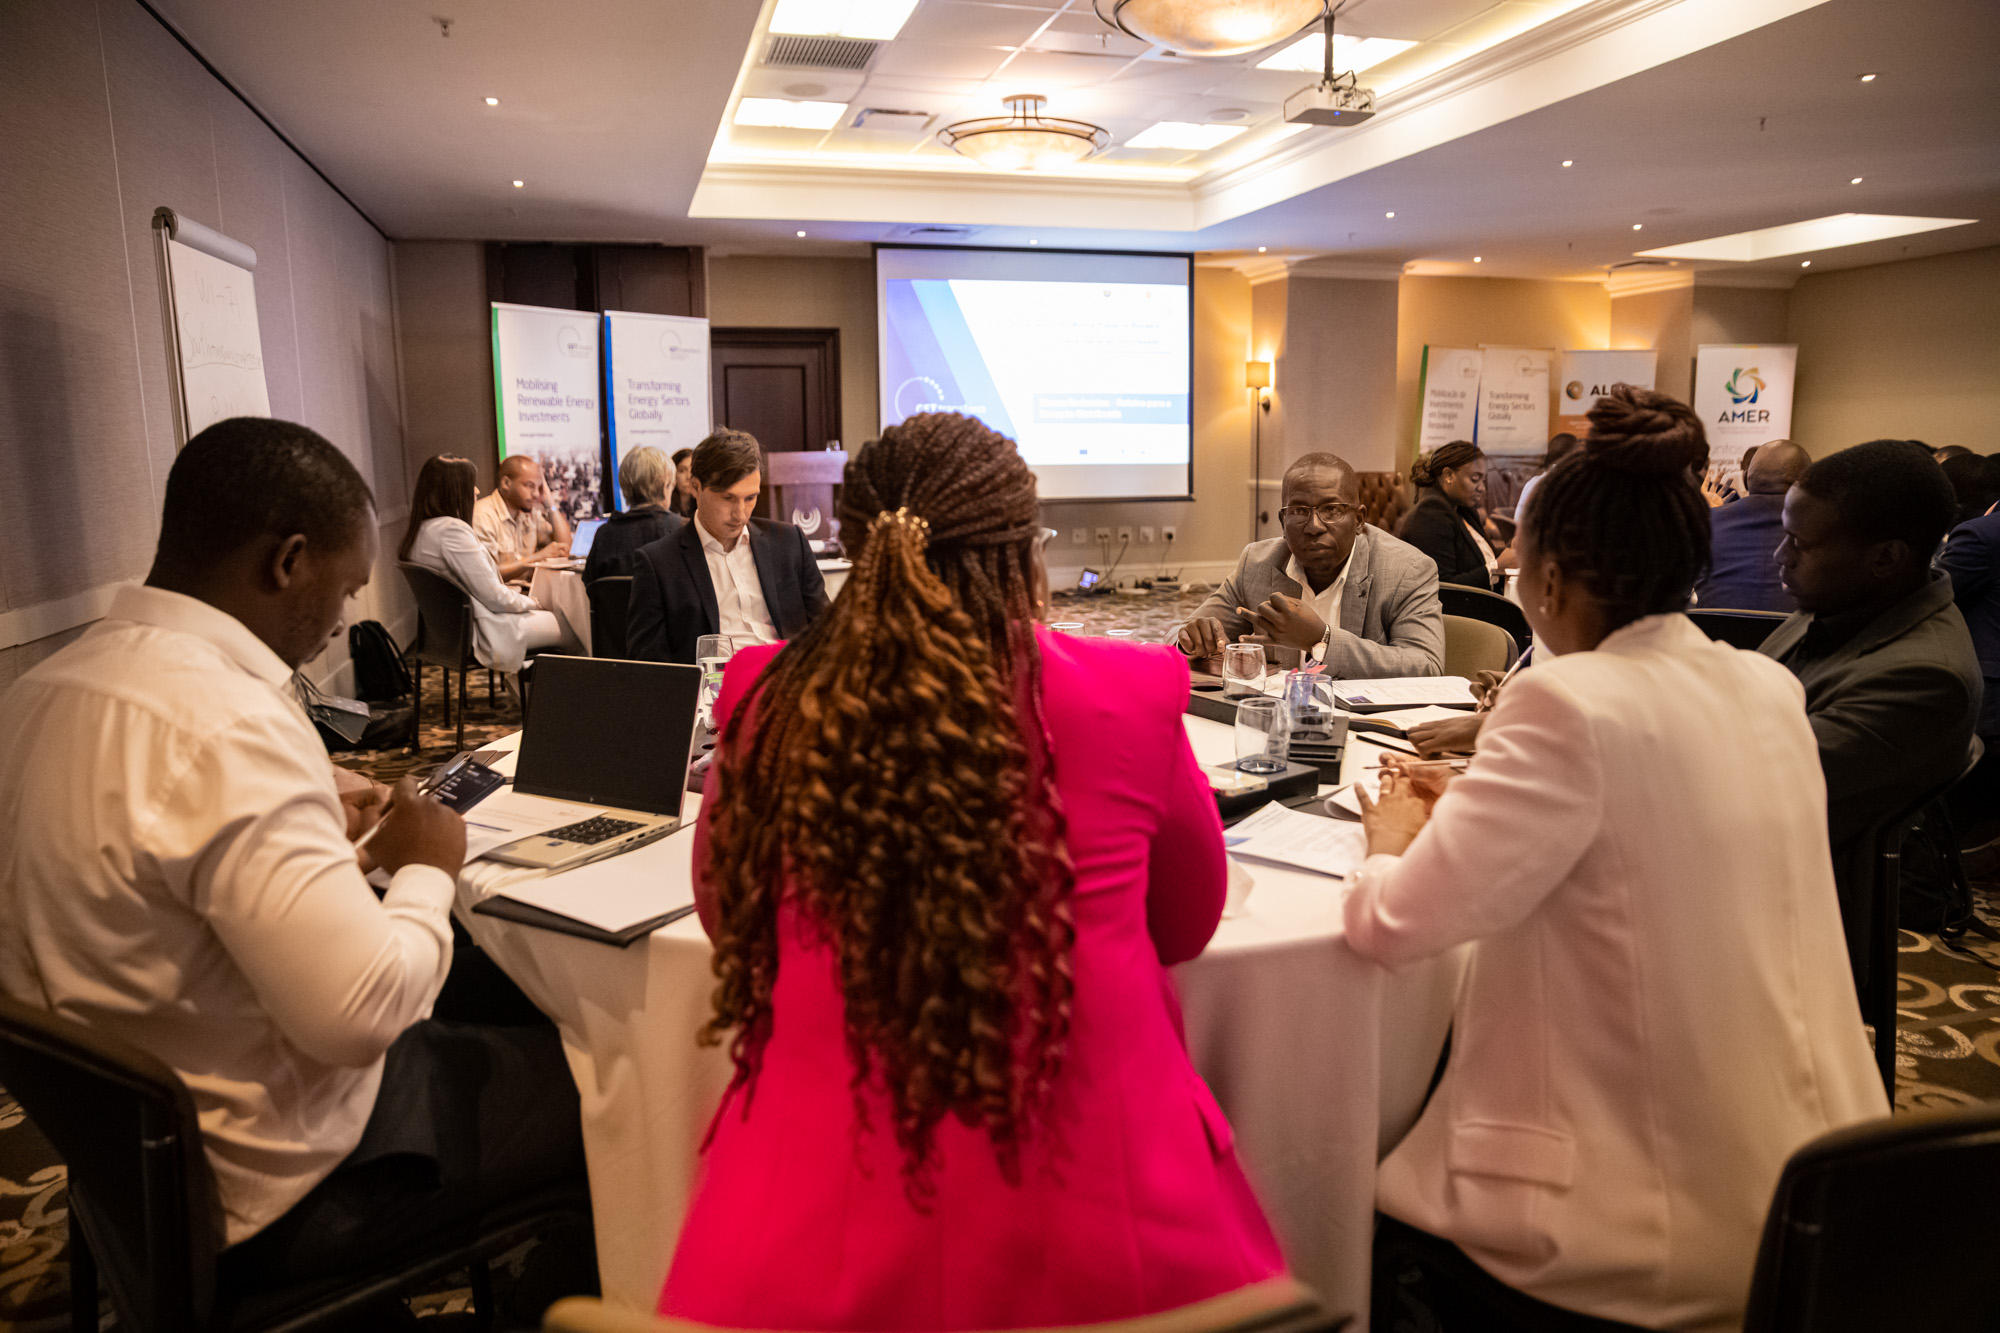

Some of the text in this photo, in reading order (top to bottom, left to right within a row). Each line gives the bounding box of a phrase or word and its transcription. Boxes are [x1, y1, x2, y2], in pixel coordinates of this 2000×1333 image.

[516, 378, 558, 393] Mobilising
[628, 378, 681, 394] Transforming
[517, 393, 594, 410] Renewable Energy
[628, 393, 690, 408] Energy Sectors
[1489, 390, 1529, 401] Transforming
[1488, 400, 1535, 411] Energy Sectors
[518, 409, 571, 423] Investments
[629, 408, 663, 423] Globally
[1488, 411, 1511, 421] Globally
[1718, 409, 1770, 423] AMER
